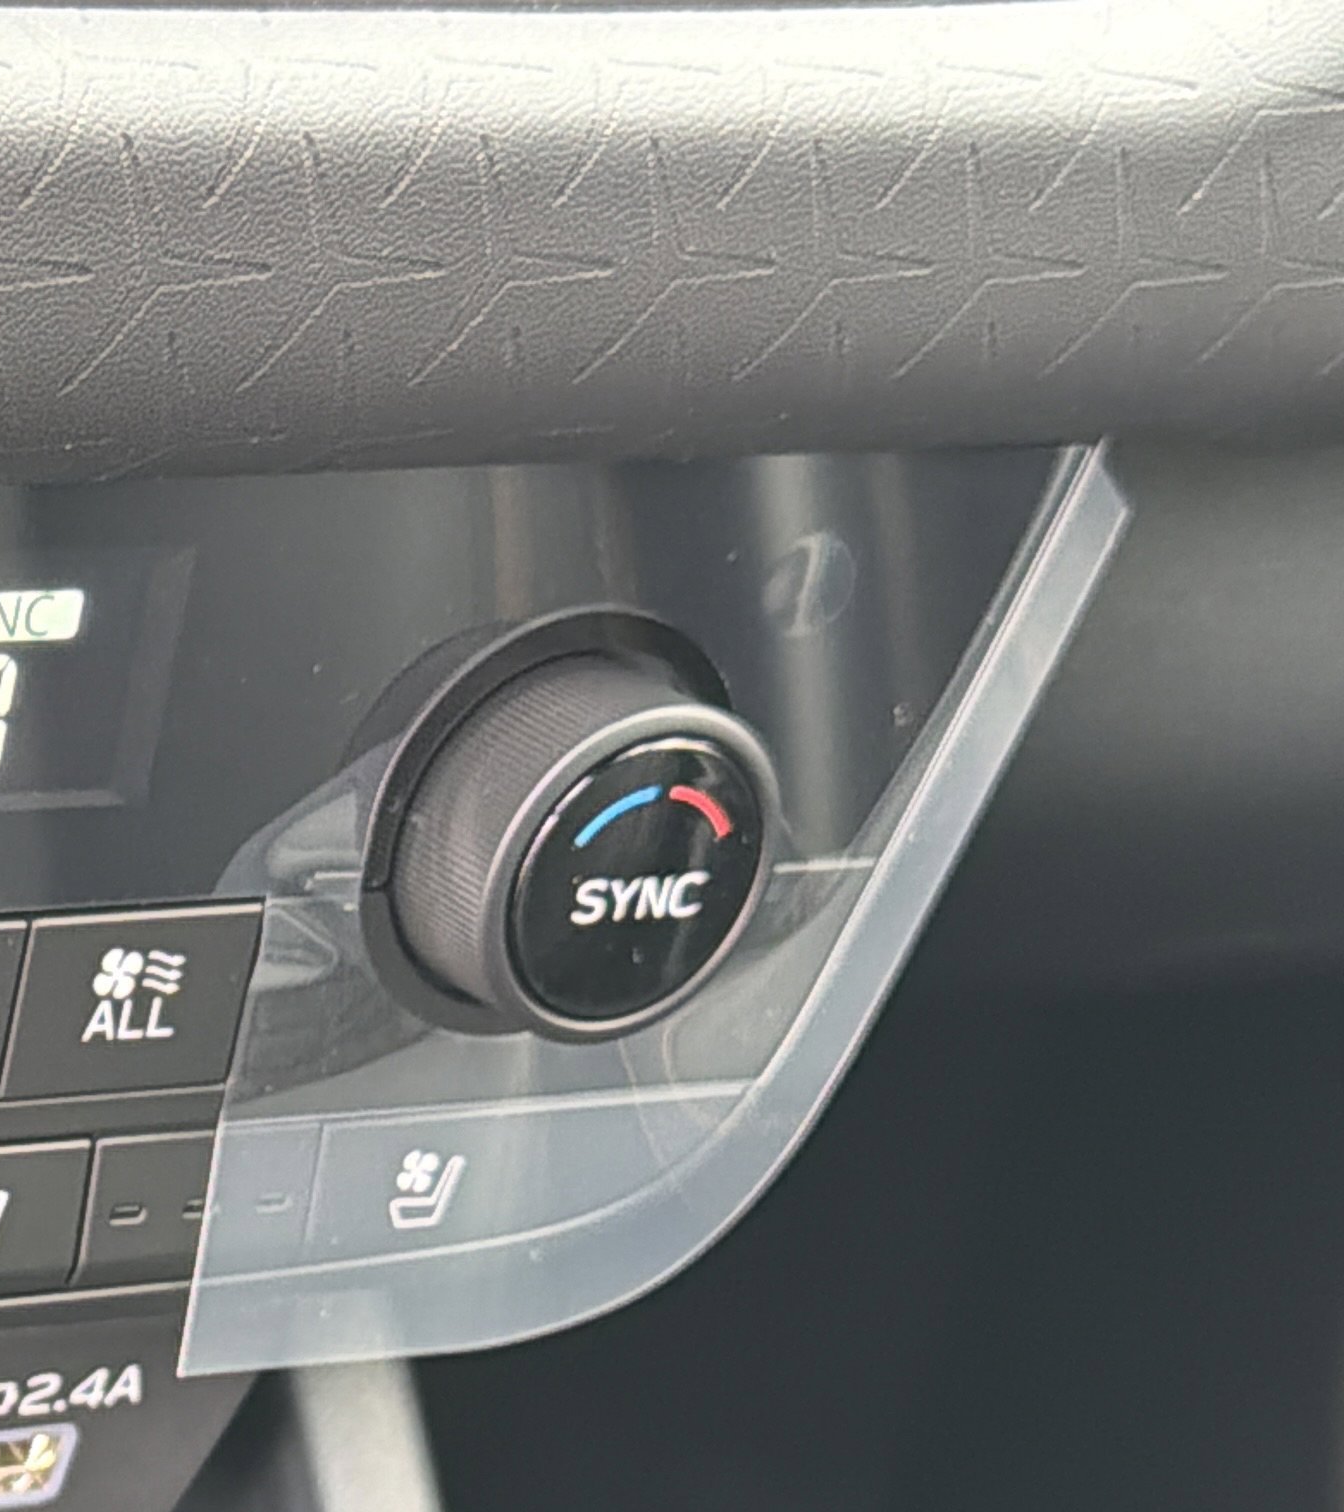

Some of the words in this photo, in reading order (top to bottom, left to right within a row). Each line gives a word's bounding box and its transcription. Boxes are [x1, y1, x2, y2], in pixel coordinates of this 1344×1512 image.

[570, 869, 712, 927] SYNC
[82, 998, 176, 1041] ALL
[18, 1364, 144, 1417] 2.4A
